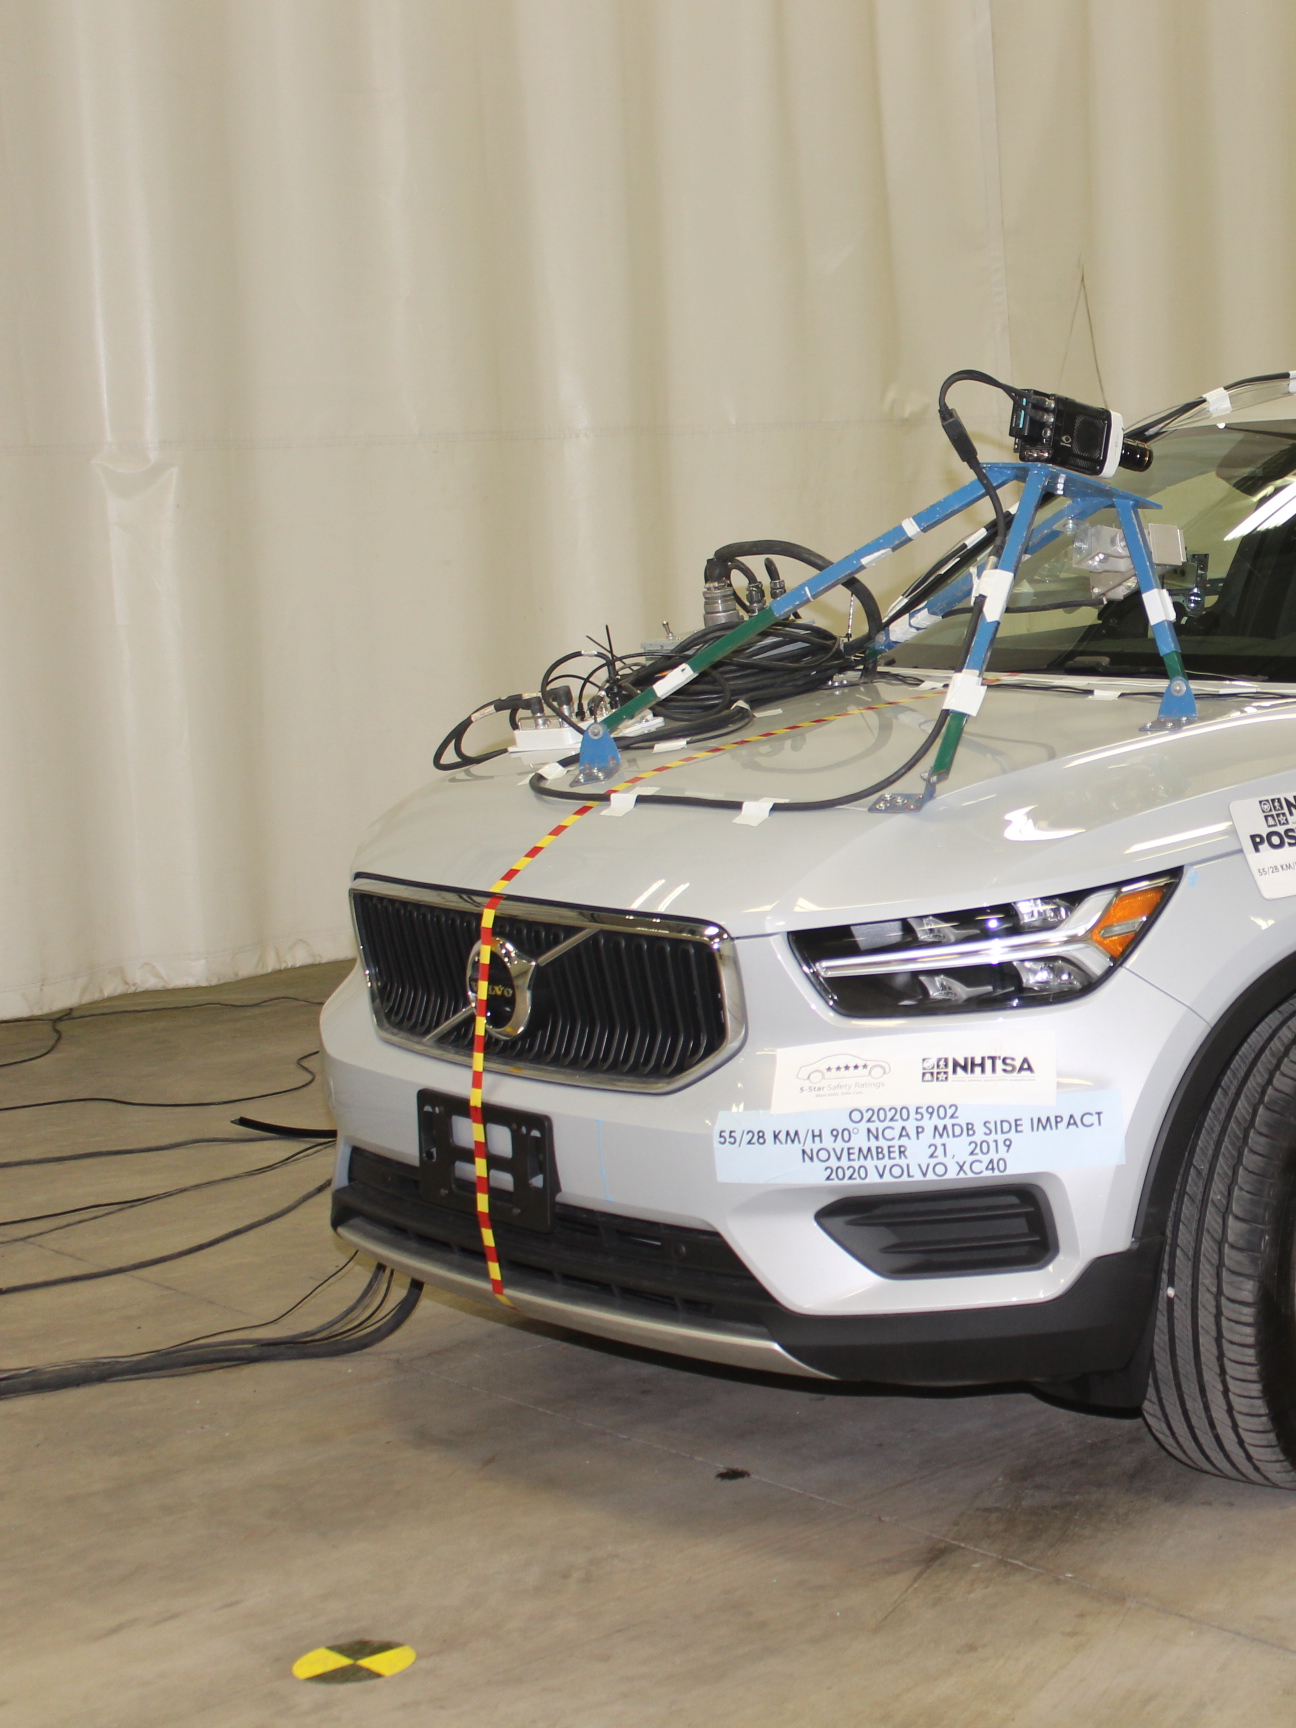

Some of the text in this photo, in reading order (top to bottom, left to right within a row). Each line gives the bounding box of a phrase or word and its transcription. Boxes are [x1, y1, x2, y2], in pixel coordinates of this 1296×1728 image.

[1258, 865, 1280, 876] 55/28
[470, 981, 513, 998] VLVO
[952, 1056, 1035, 1075] NHTSA
[799, 1080, 885, 1094] 5-Star Safety Ratings
[718, 1111, 1104, 1147] 55/28 KM/H 90° NCAP MDB SIDE IMPACT
[801, 1138, 1013, 1163] NOVEMBER 21, 2019
[824, 1157, 1008, 1181] 2020 VOLVO XC40
